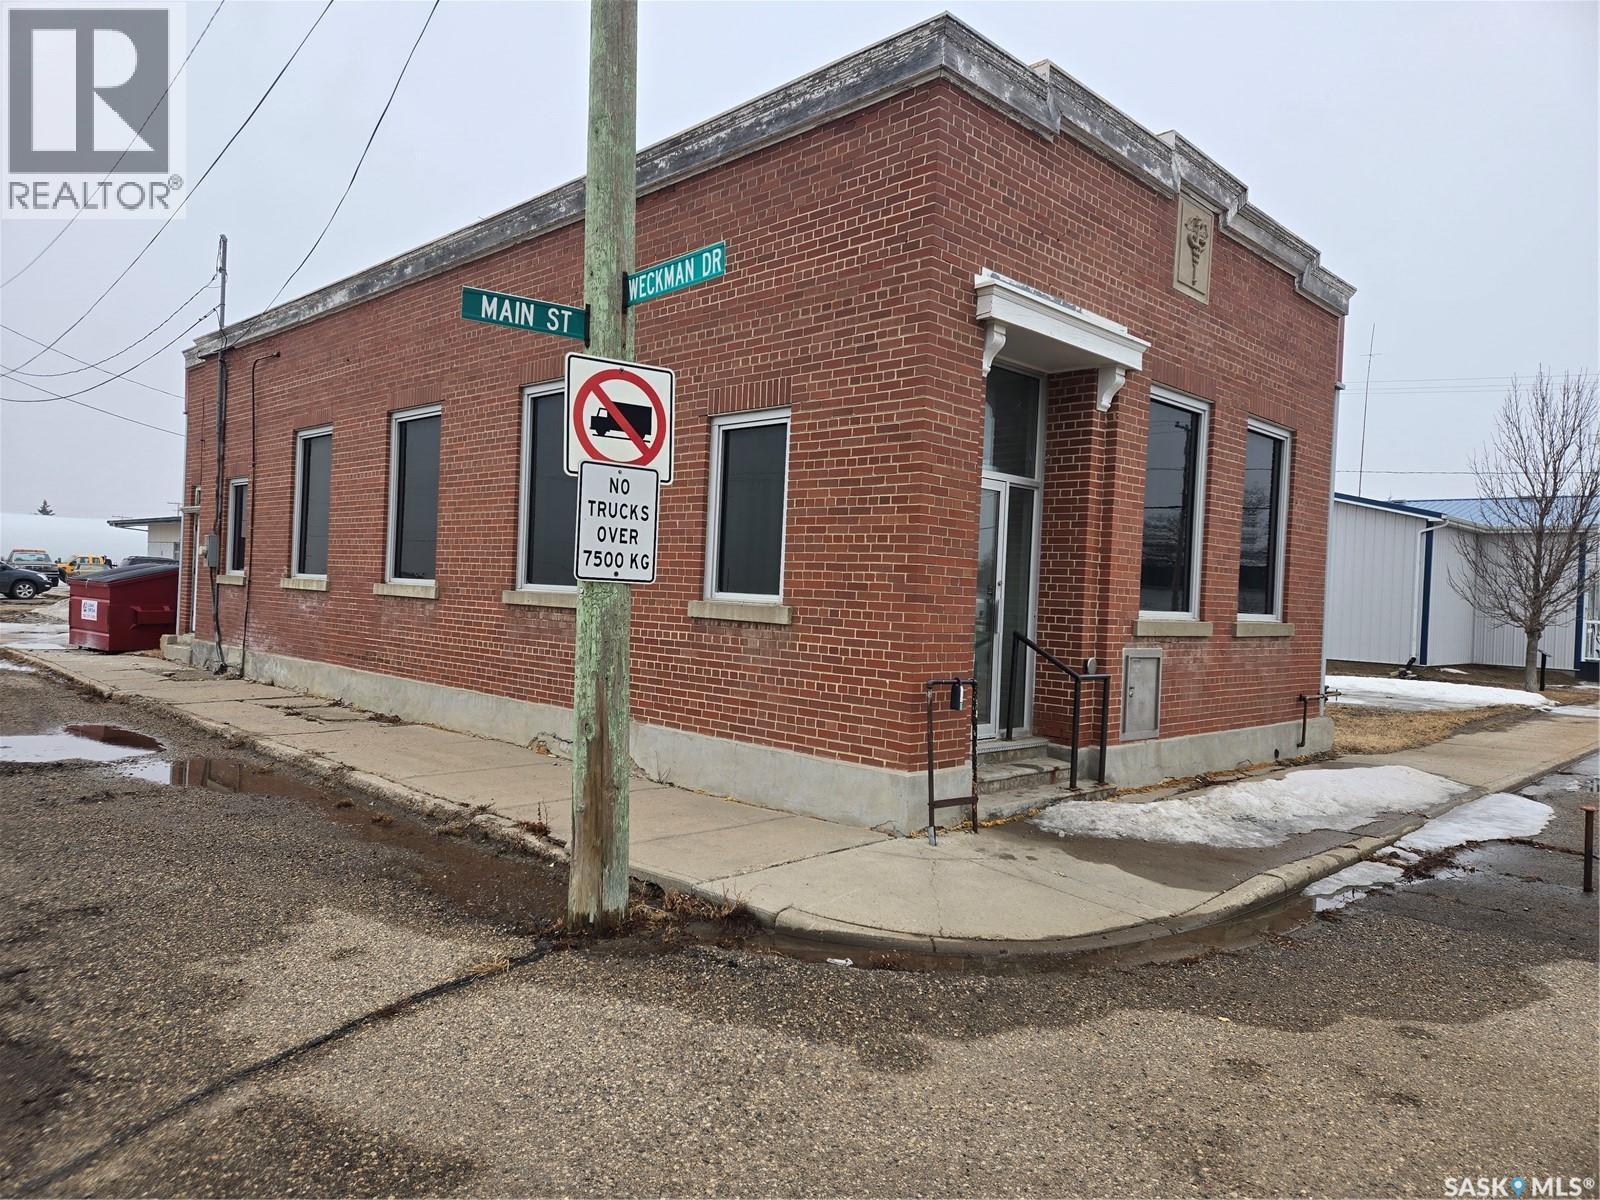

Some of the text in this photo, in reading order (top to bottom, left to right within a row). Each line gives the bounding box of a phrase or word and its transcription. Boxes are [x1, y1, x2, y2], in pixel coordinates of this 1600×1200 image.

[628, 248, 722, 301] WECKMAN DR
[480, 295, 572, 333] MAIN ST
[609, 477, 630, 495] NO
[588, 499, 649, 521] TRUCKS
[597, 526, 638, 544] OVER
[583, 550, 650, 570] 7500 KG
